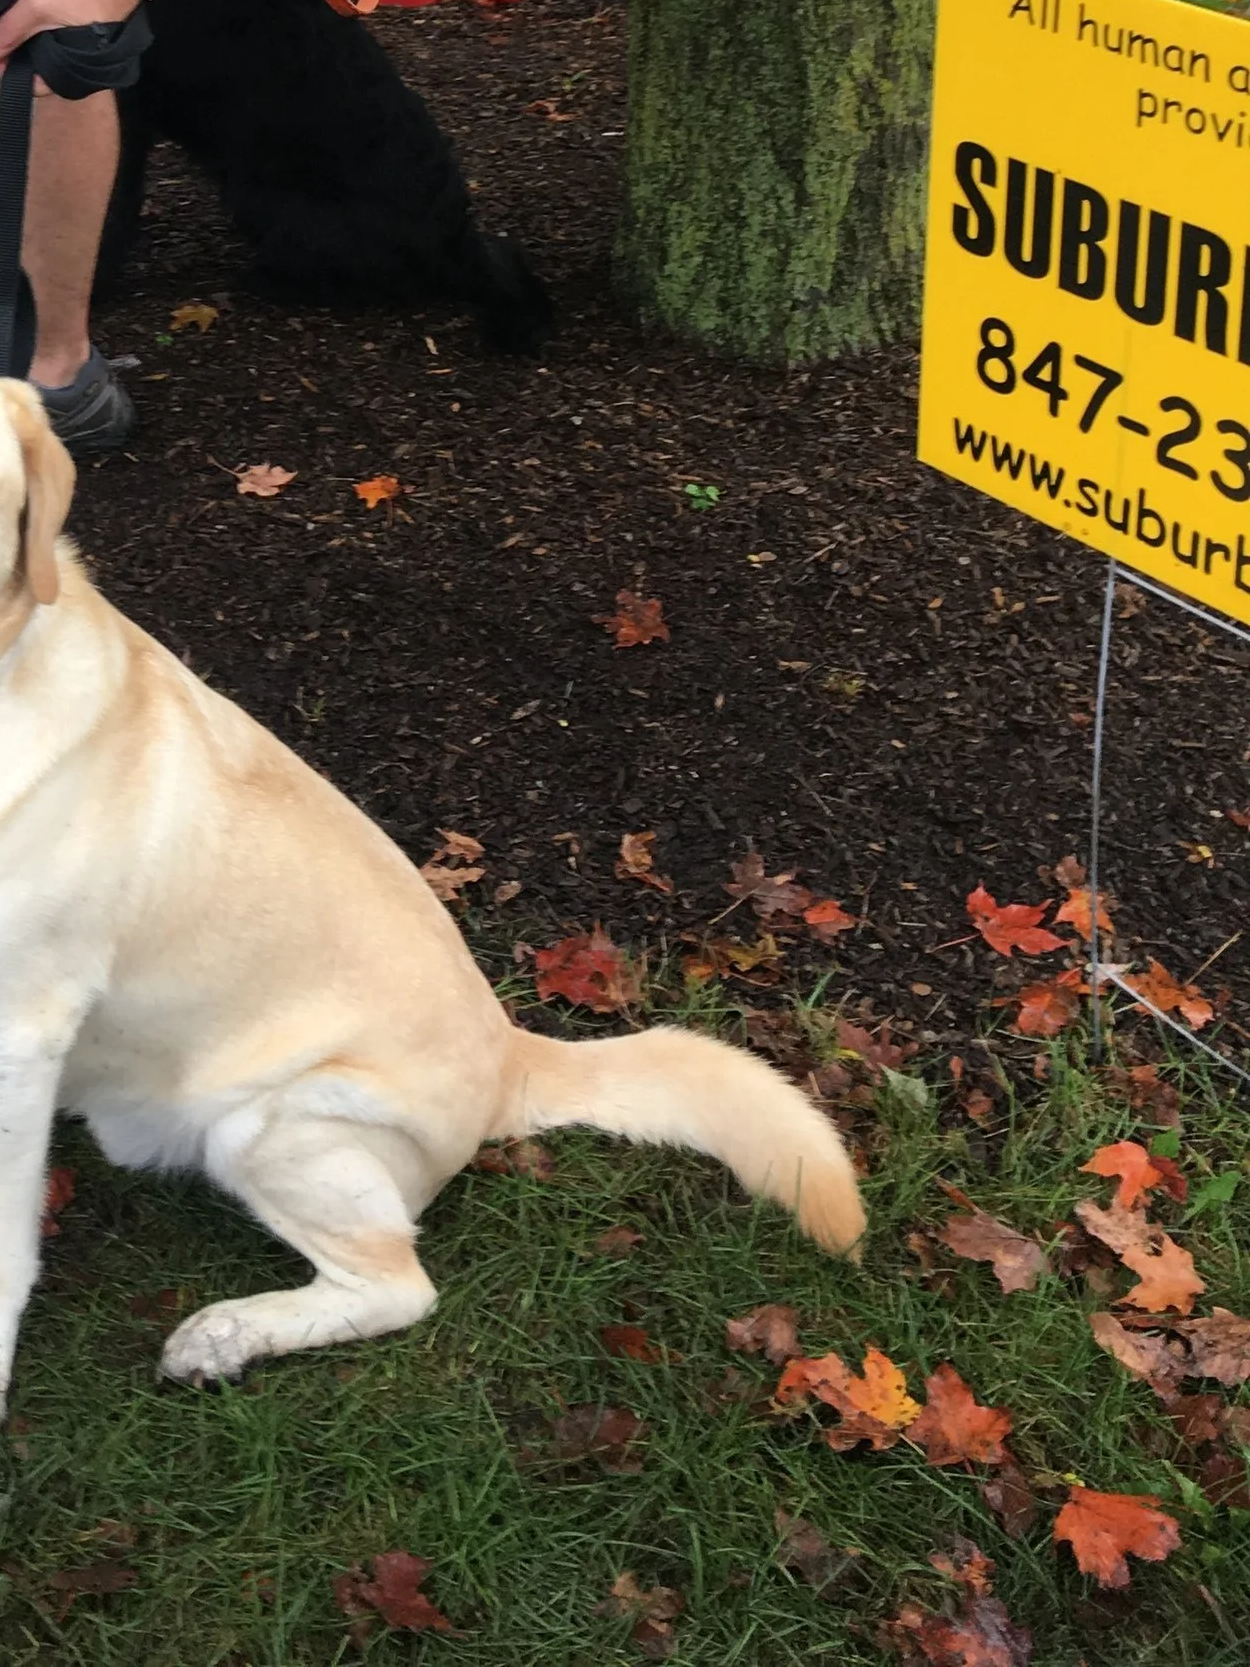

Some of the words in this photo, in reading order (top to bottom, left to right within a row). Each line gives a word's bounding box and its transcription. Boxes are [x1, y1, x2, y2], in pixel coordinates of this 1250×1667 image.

[1076, 2, 1212, 83] human
[951, 140, 1250, 368] SUBUR
[976, 316, 1250, 503] 847-23
